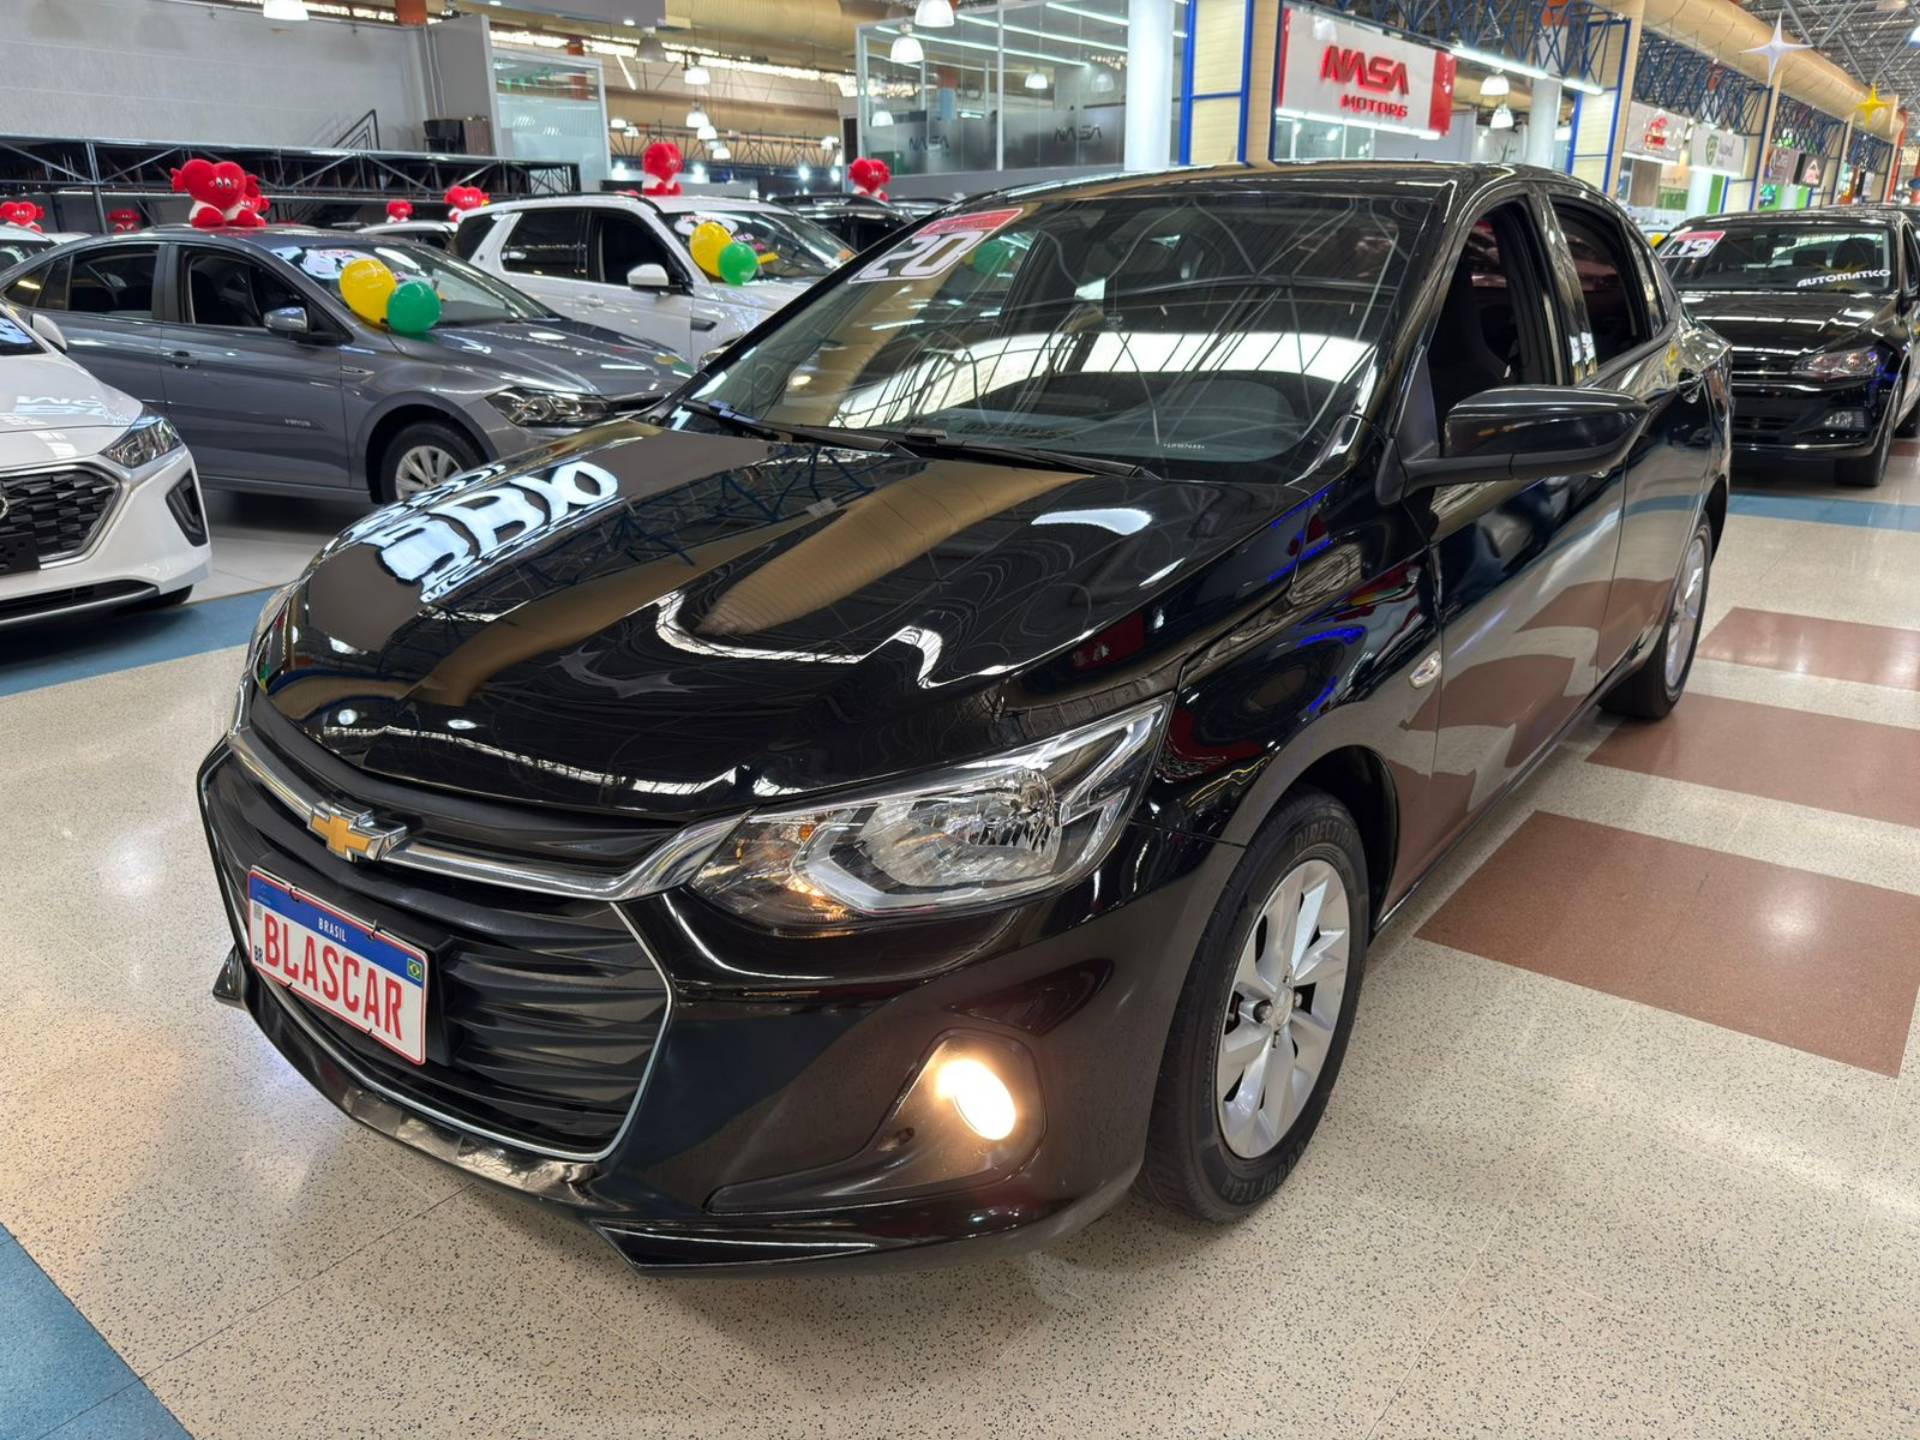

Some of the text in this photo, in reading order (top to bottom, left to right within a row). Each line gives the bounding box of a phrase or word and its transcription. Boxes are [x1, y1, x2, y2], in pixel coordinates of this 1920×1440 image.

[1321, 45, 1409, 96] NASA
[1341, 94, 1408, 119] MOTORS
[908, 135, 950, 152] NASA
[1054, 124, 1102, 143] NASA
[859, 230, 984, 279] 20
[1678, 239, 1714, 257] 19
[318, 917, 347, 942] BRASIL
[254, 945, 263, 964] BR
[264, 913, 403, 1041] BLASCAR
